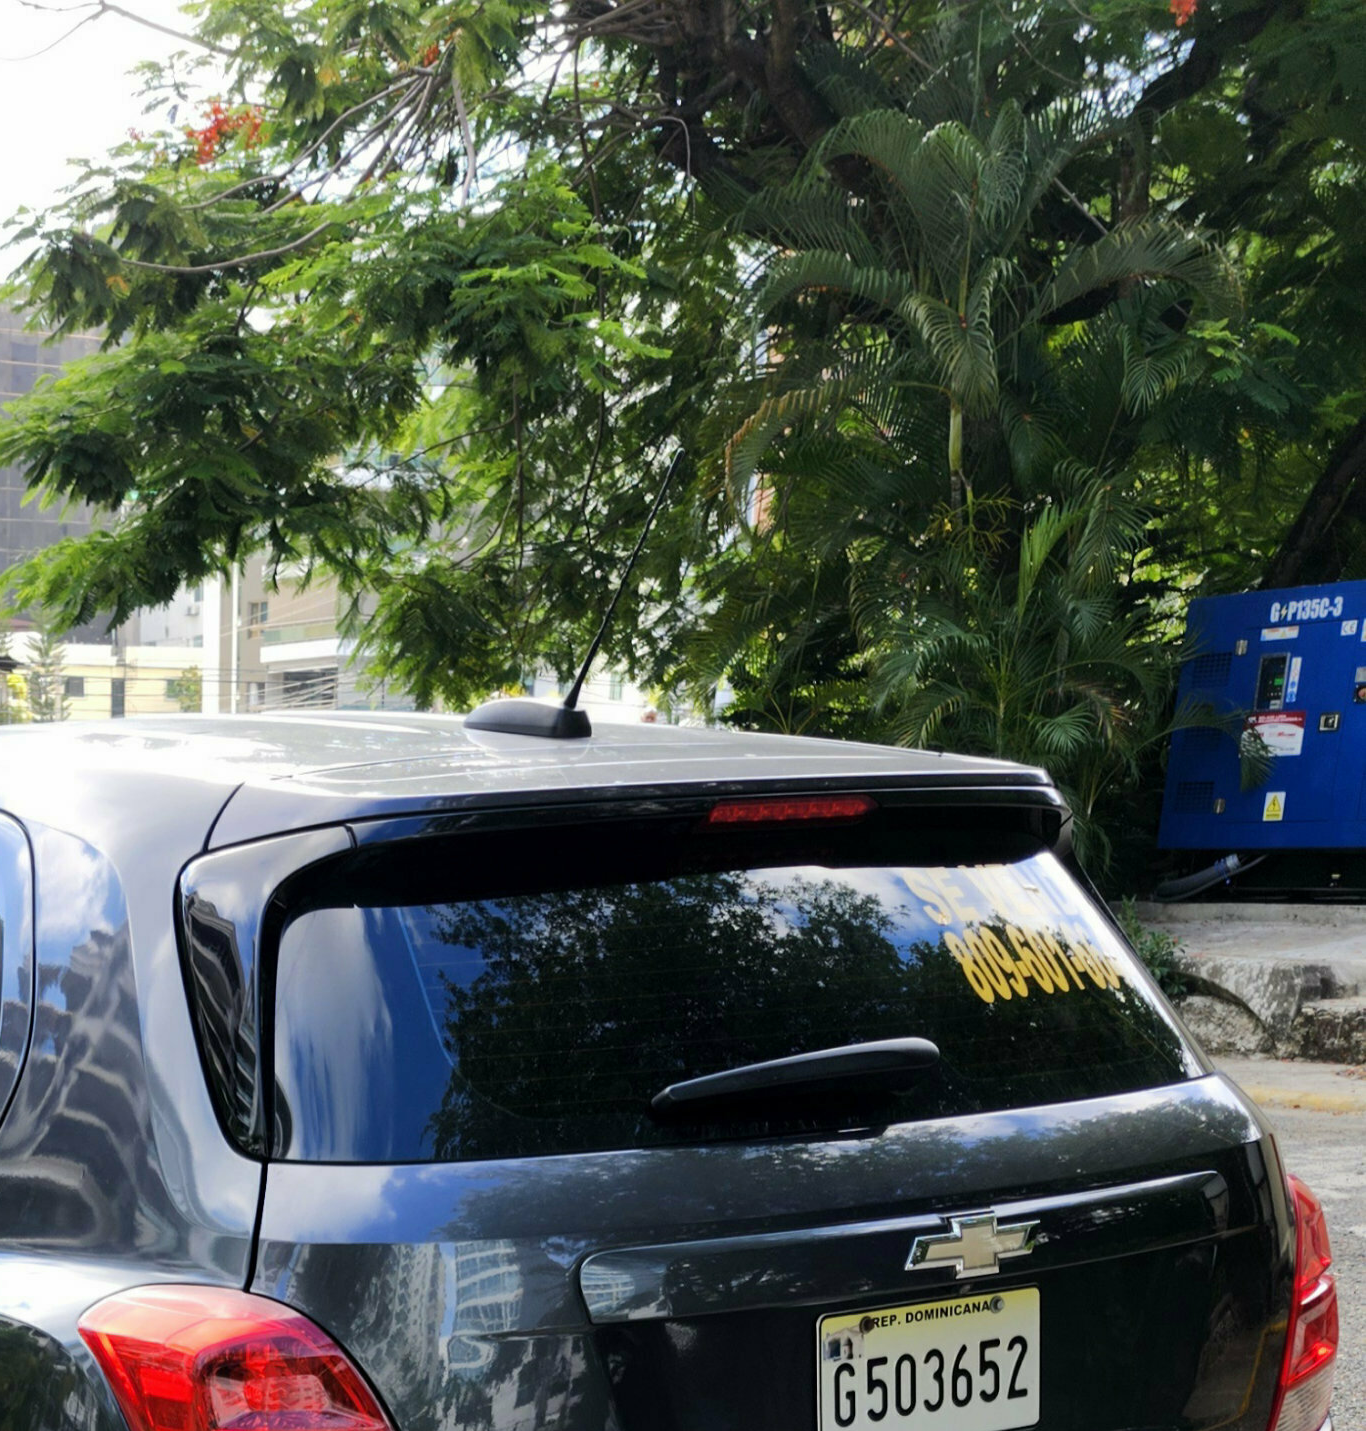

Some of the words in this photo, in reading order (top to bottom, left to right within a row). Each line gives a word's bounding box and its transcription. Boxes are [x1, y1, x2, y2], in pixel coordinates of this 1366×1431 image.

[901, 867, 979, 926] SE
[873, 1314, 901, 1329] REP.
[905, 1300, 992, 1324] DOMINICANA
[833, 1335, 1028, 1428] G503652
